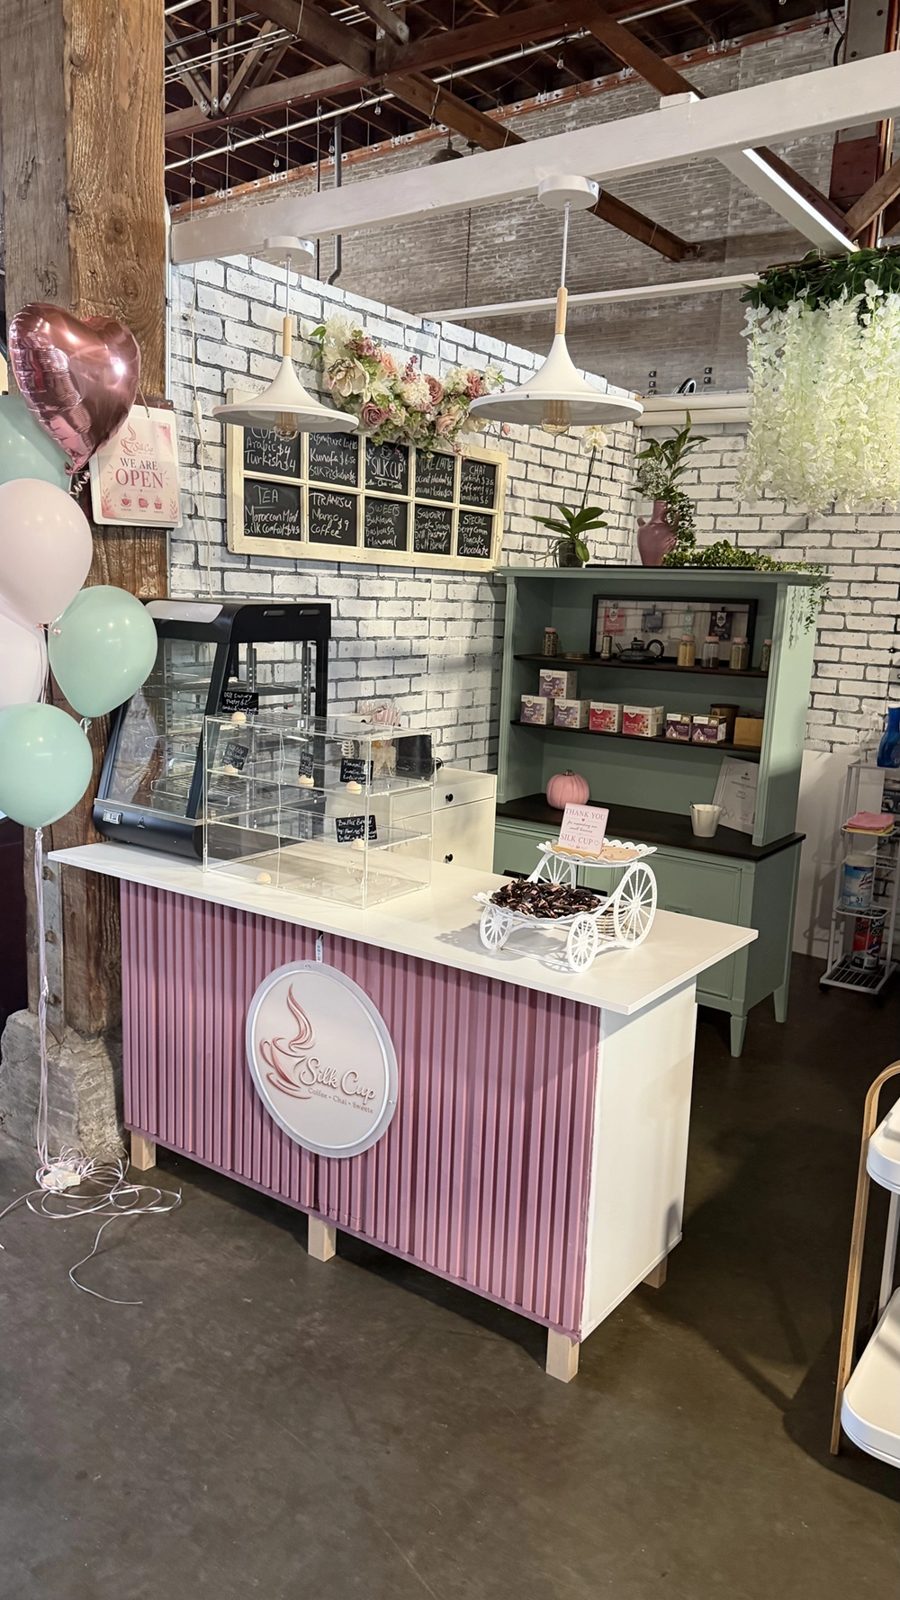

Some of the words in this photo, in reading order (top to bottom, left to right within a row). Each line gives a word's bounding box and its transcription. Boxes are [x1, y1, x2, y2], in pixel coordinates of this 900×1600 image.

[246, 436, 276, 452] Arabic
[120, 457, 136, 469] WE
[139, 460, 158, 471] ARE
[244, 449, 283, 468] Turkish
[371, 456, 390, 477] SILK
[390, 462, 404, 479] CUP
[115, 468, 163, 489] OPEN
[253, 484, 278, 505] TEA
[245, 505, 282, 522] Moroccan
[310, 523, 342, 539] Coffee
[565, 808, 589, 818] THANK
[591, 812, 606, 820] YOU
[560, 833, 576, 842] SILK
[578, 837, 593, 845] CUP
[299, 1056, 338, 1090] Silk
[340, 1070, 376, 1105] Cup
